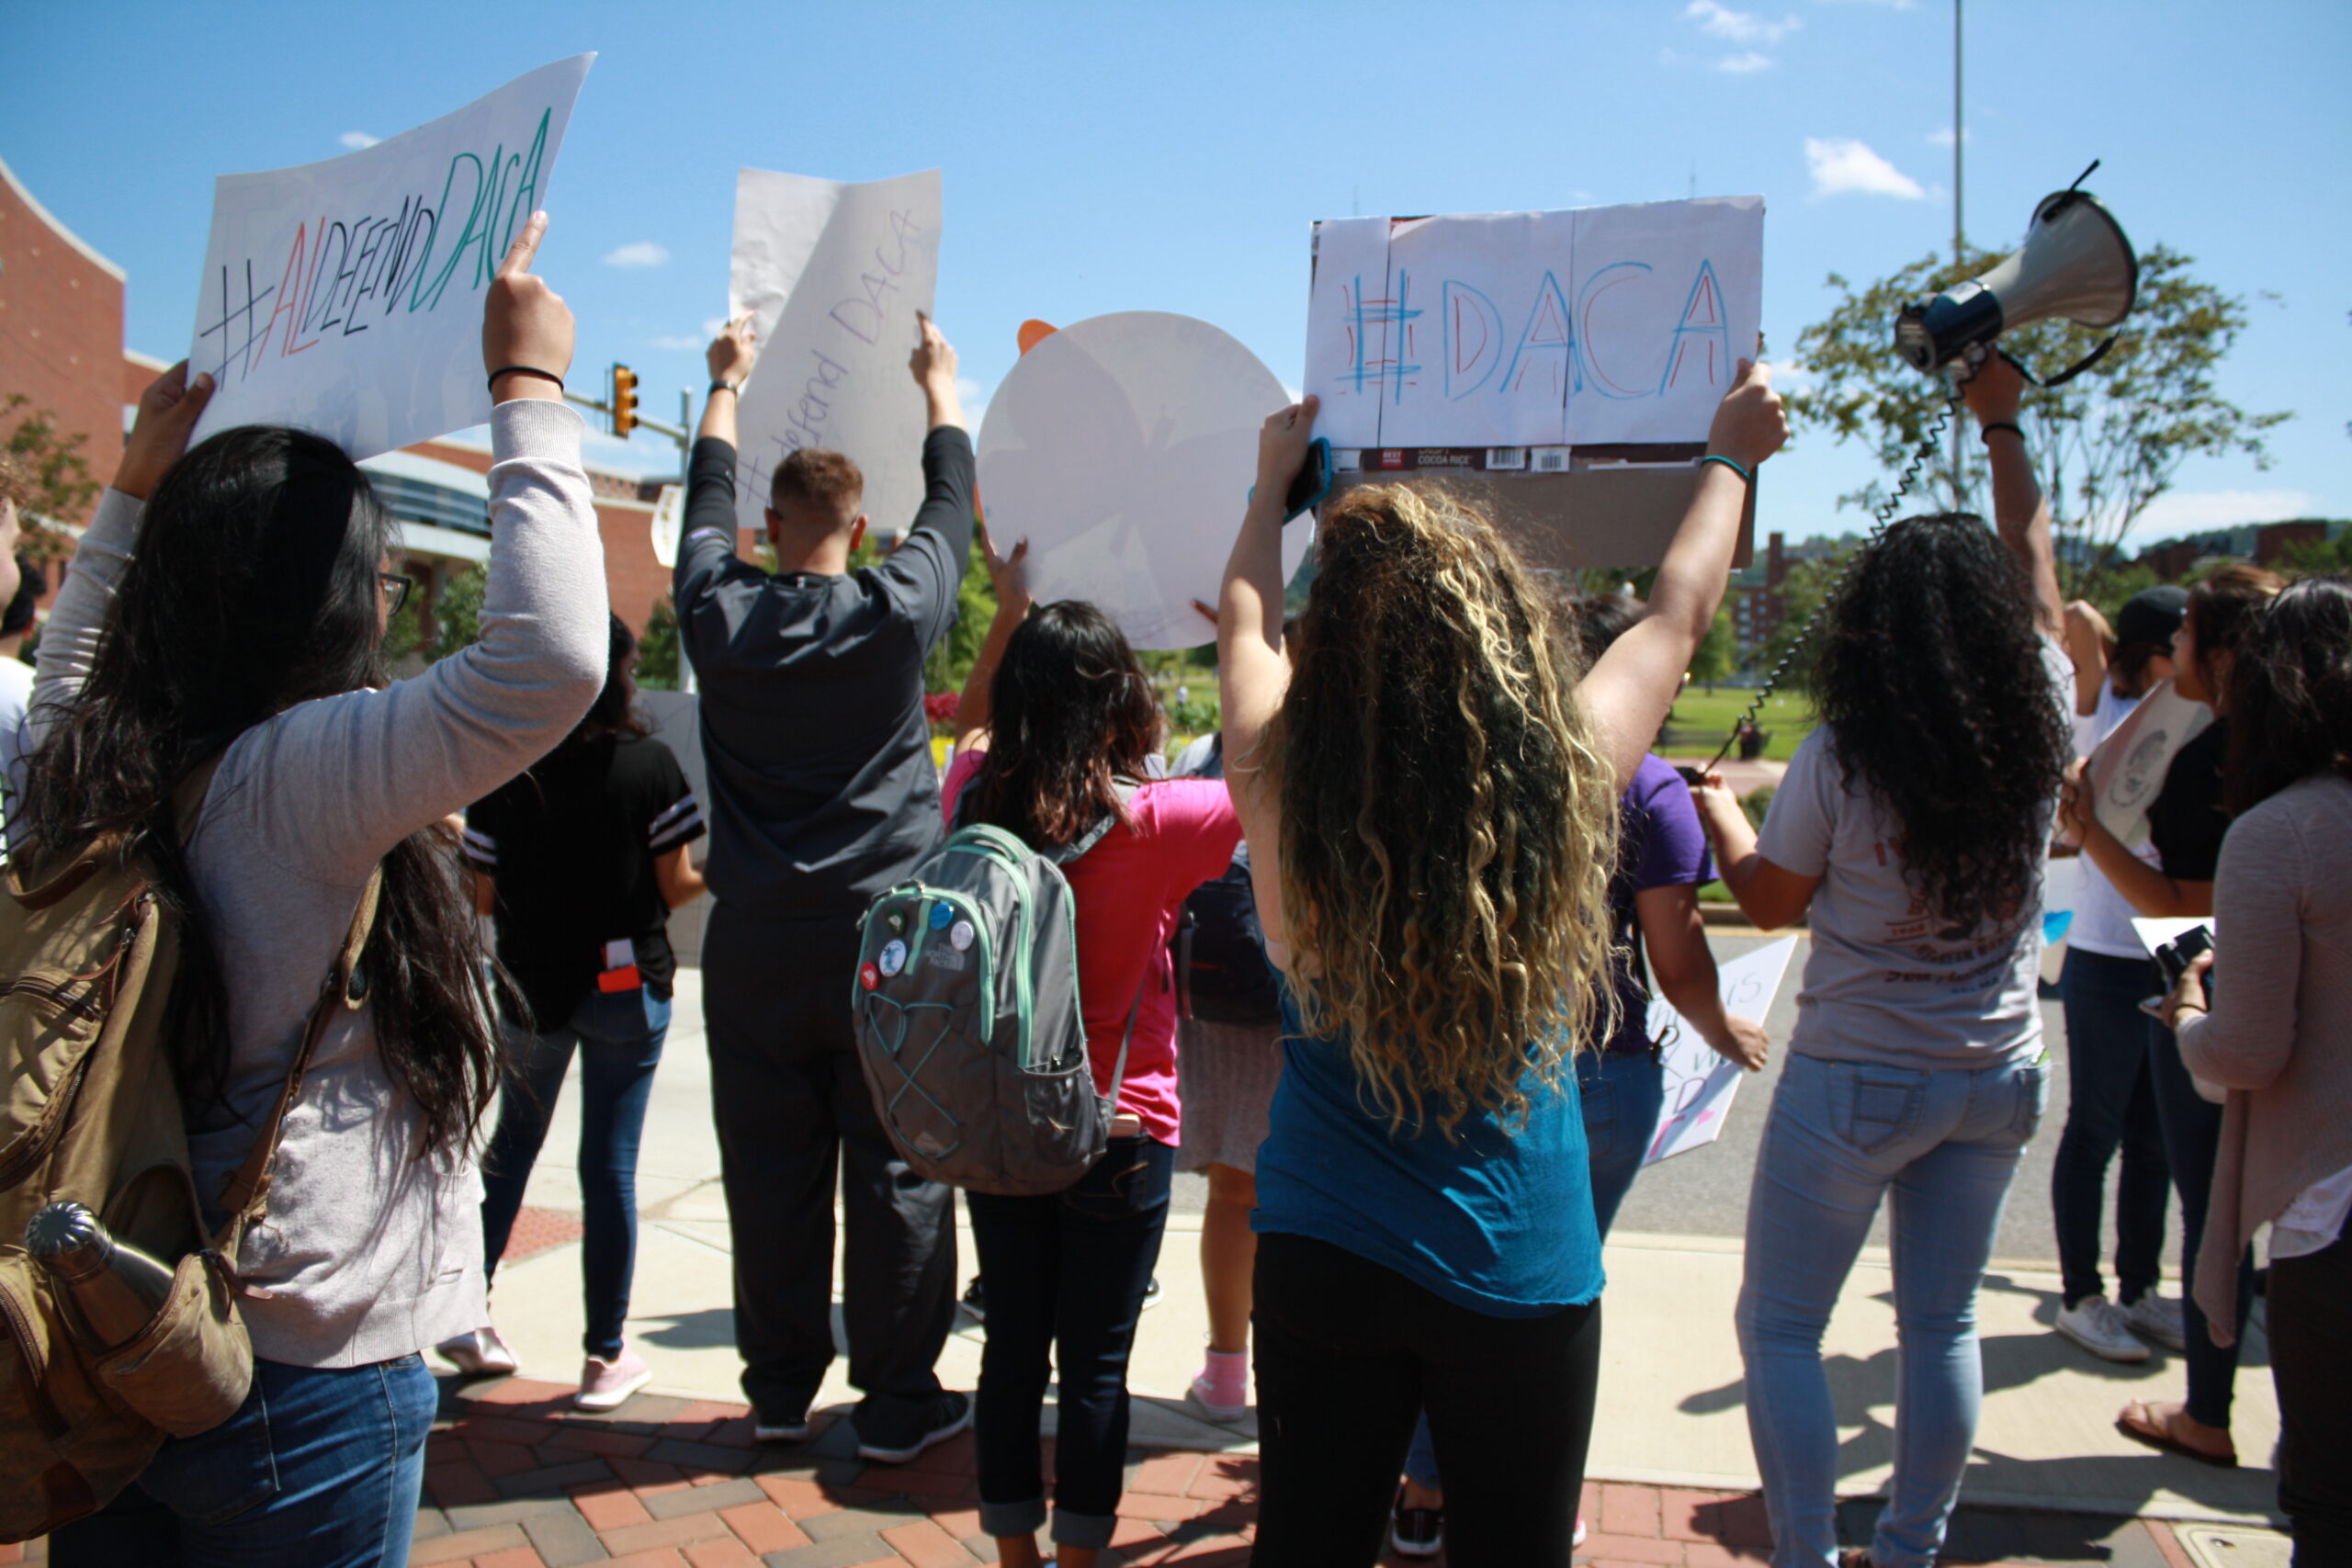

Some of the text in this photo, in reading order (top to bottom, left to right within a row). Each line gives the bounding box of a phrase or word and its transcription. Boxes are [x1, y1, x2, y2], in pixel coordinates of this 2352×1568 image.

[830, 209, 921, 345] DACA
[1335, 258, 1732, 404] #DACA
[1418, 455, 1448, 465] COCOA
